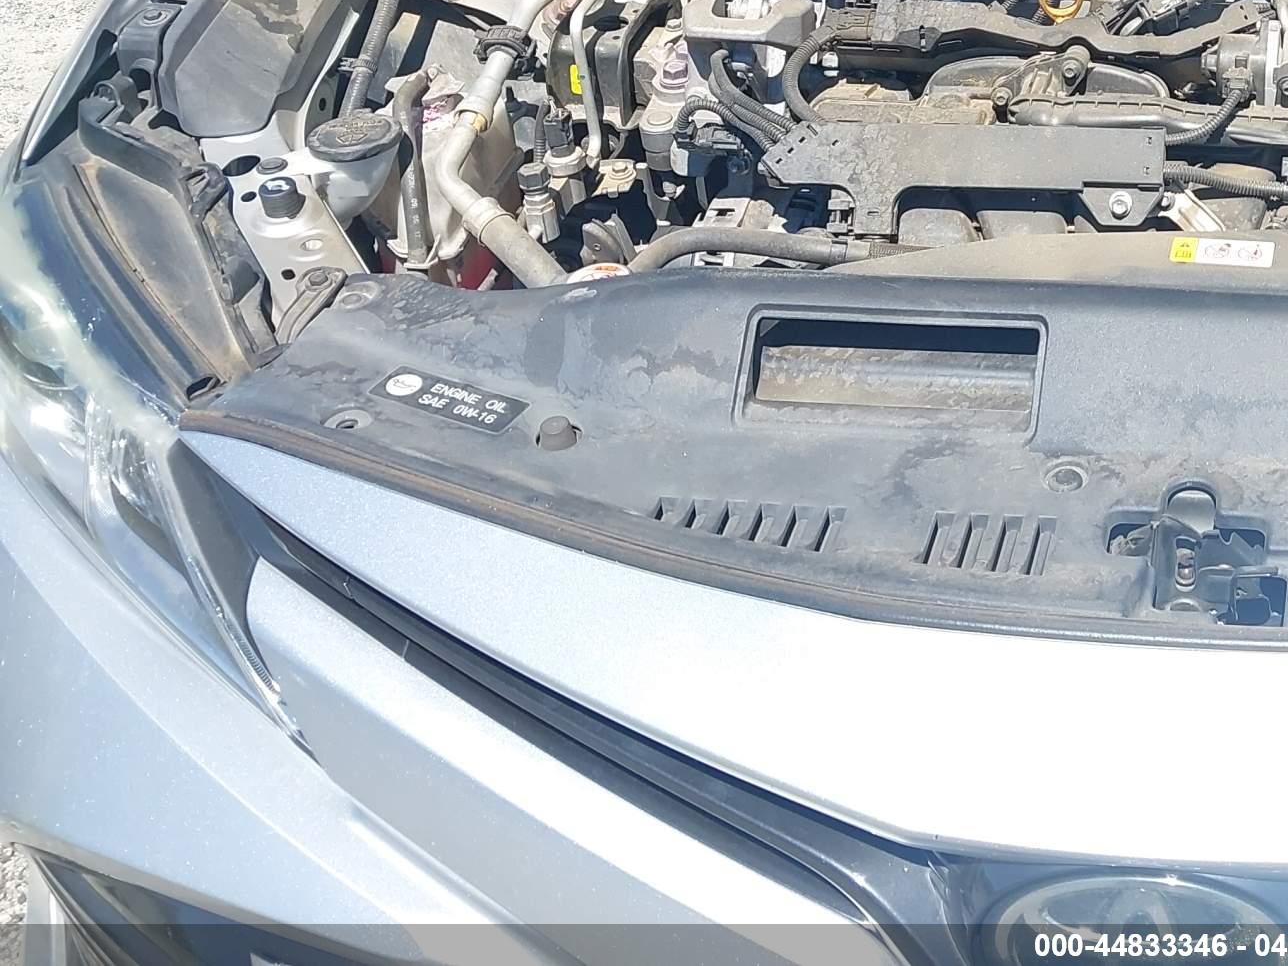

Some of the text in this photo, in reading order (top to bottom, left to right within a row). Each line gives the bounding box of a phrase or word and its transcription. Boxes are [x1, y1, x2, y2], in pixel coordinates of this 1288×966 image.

[418, 394, 497, 424] SAE 0W-16
[430, 383, 506, 414] ENGINE OIL
